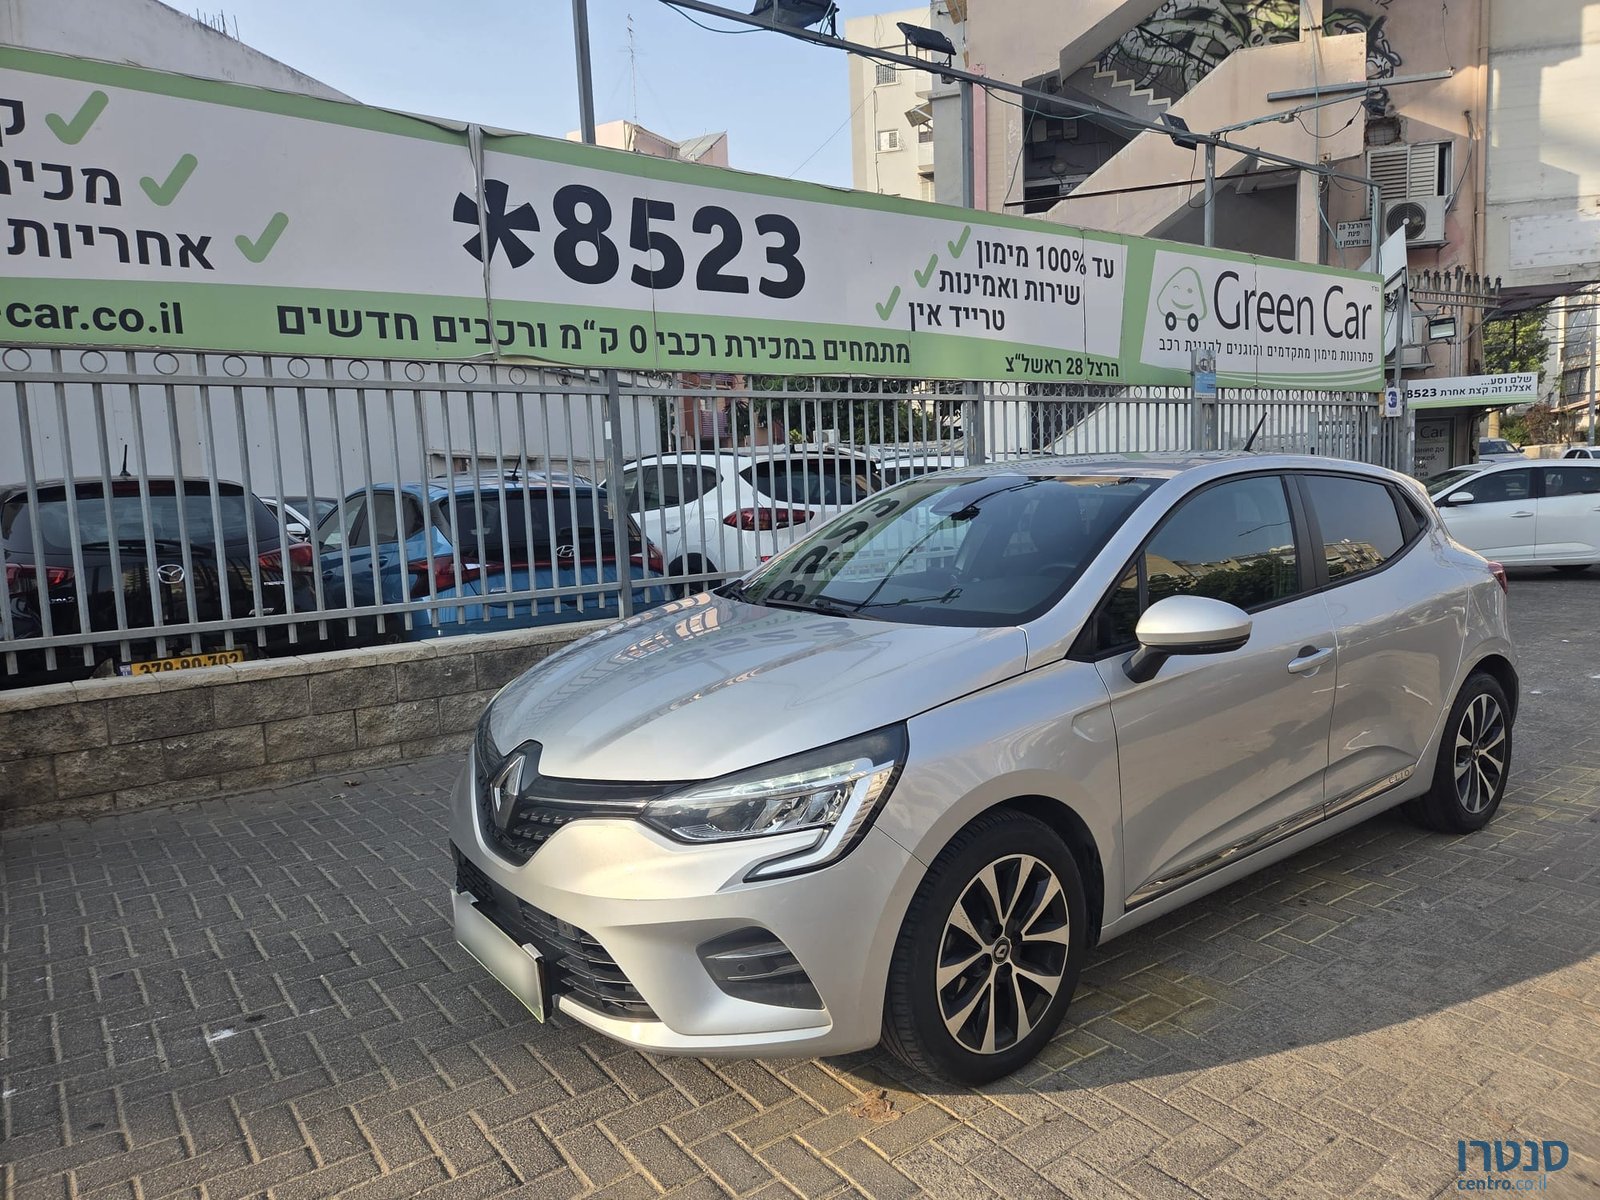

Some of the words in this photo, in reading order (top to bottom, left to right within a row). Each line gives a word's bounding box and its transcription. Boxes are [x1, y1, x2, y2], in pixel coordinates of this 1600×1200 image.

[0, 98, 25, 147] ק
[8, 217, 215, 270] אחריות
[976, 240, 1029, 269] מימון
[1036, 245, 1087, 276] 100%
[1092, 256, 1114, 279] עד
[938, 270, 1018, 299] ואמינות
[1024, 279, 1081, 306] שירות
[0, 301, 184, 335] car.co.il
[908, 302, 942, 331] אין
[949, 305, 1006, 331] טרייד
[1213, 270, 1315, 337] Green
[1323, 285, 1373, 340] Car
[276, 305, 420, 342] חדשים
[432, 316, 548, 348] ורכבים
[629, 324, 648, 354] 0
[656, 331, 717, 357] רכבי
[724, 335, 817, 361] במכירת
[823, 340, 911, 364] מתמחים
[1159, 338, 1180, 352] רכב
[1226, 342, 1263, 356] והוגנים
[1267, 341, 1311, 361] מתקדמים
[1314, 343, 1337, 362] מימון
[1340, 345, 1374, 363] פתרונות
[1065, 357, 1083, 375] 28
[1086, 358, 1119, 377] הרצל
[1440, 388, 1467, 397] אחרת
[1469, 387, 1488, 396] קצת
[1504, 384, 1532, 393] אצלנו
[1510, 375, 1532, 384] שלם
